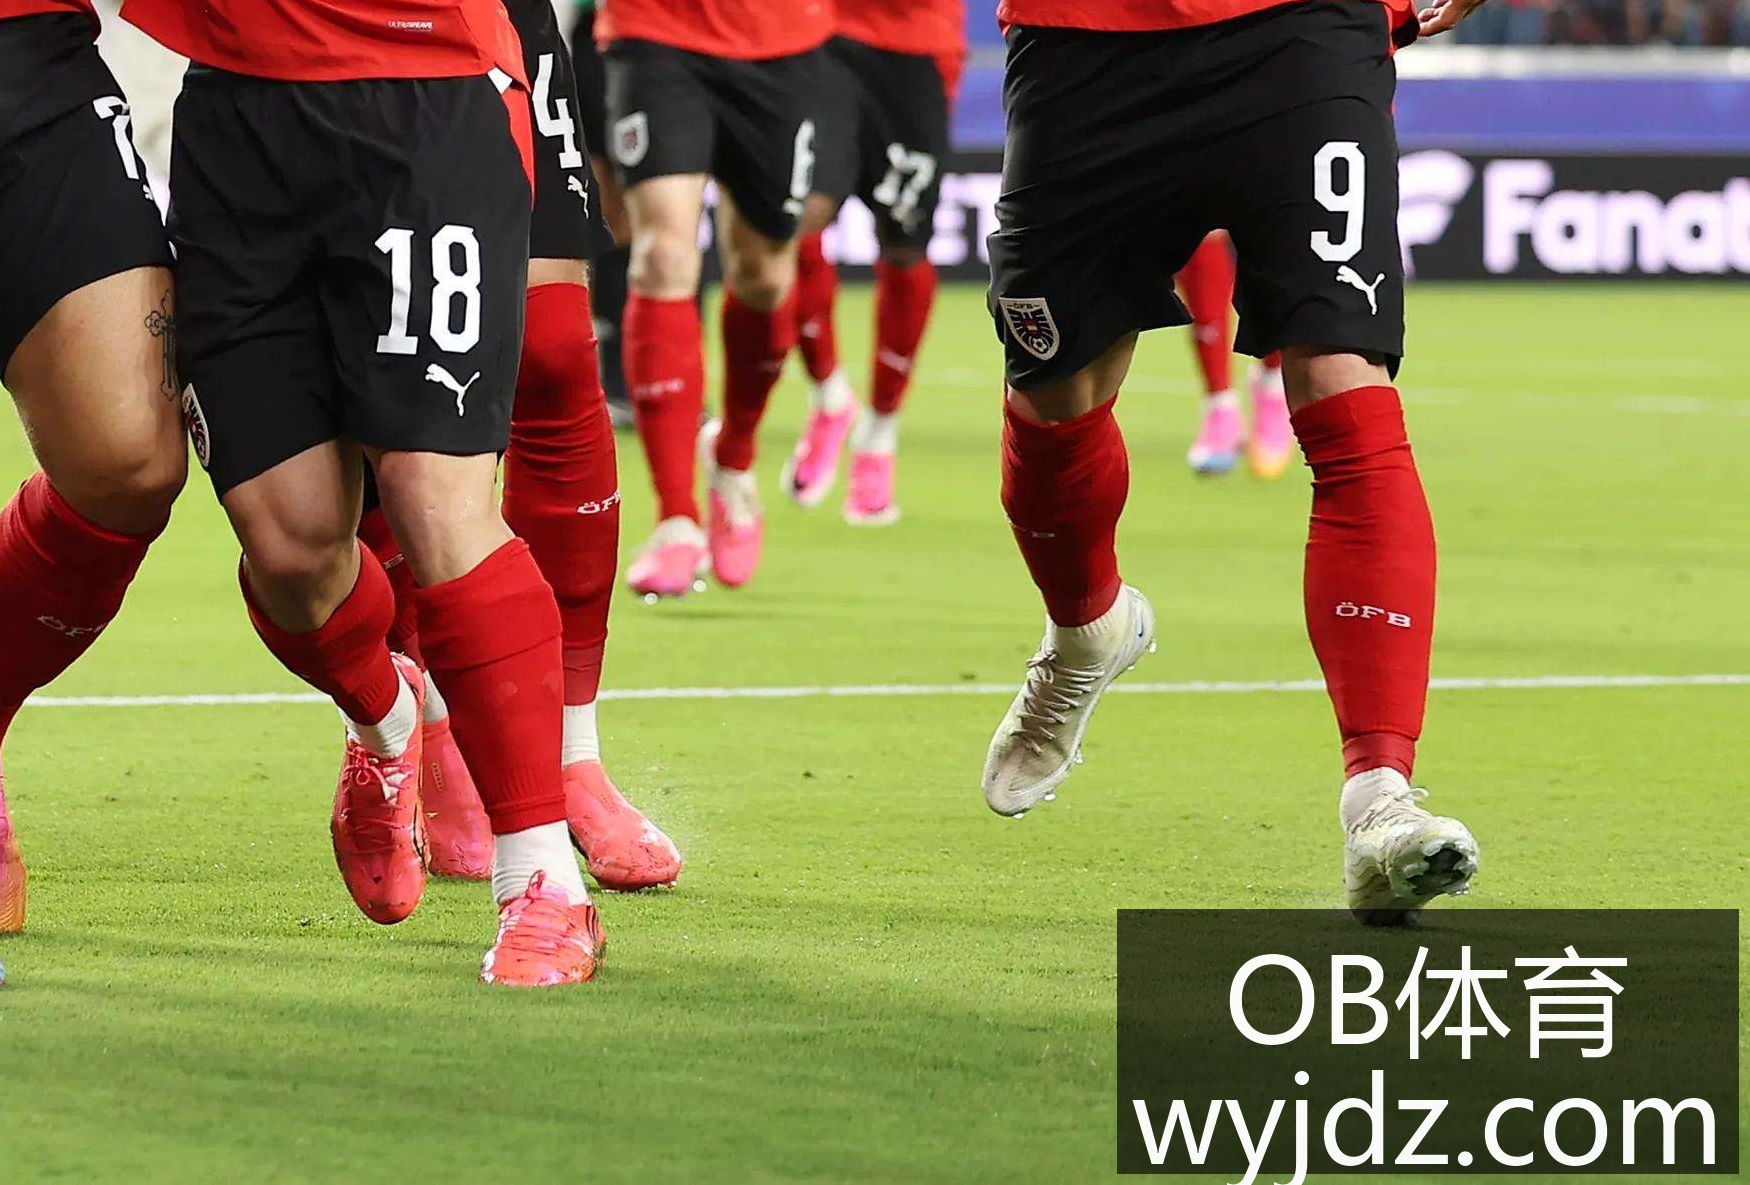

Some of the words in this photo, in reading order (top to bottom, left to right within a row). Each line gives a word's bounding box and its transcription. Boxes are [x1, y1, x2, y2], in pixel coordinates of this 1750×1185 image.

[93, 96, 140, 180] 7
[532, 53, 583, 169] 4
[1310, 141, 1366, 263] 9
[374, 224, 482, 355] 18
[1334, 601, 1412, 628] ÖFB
